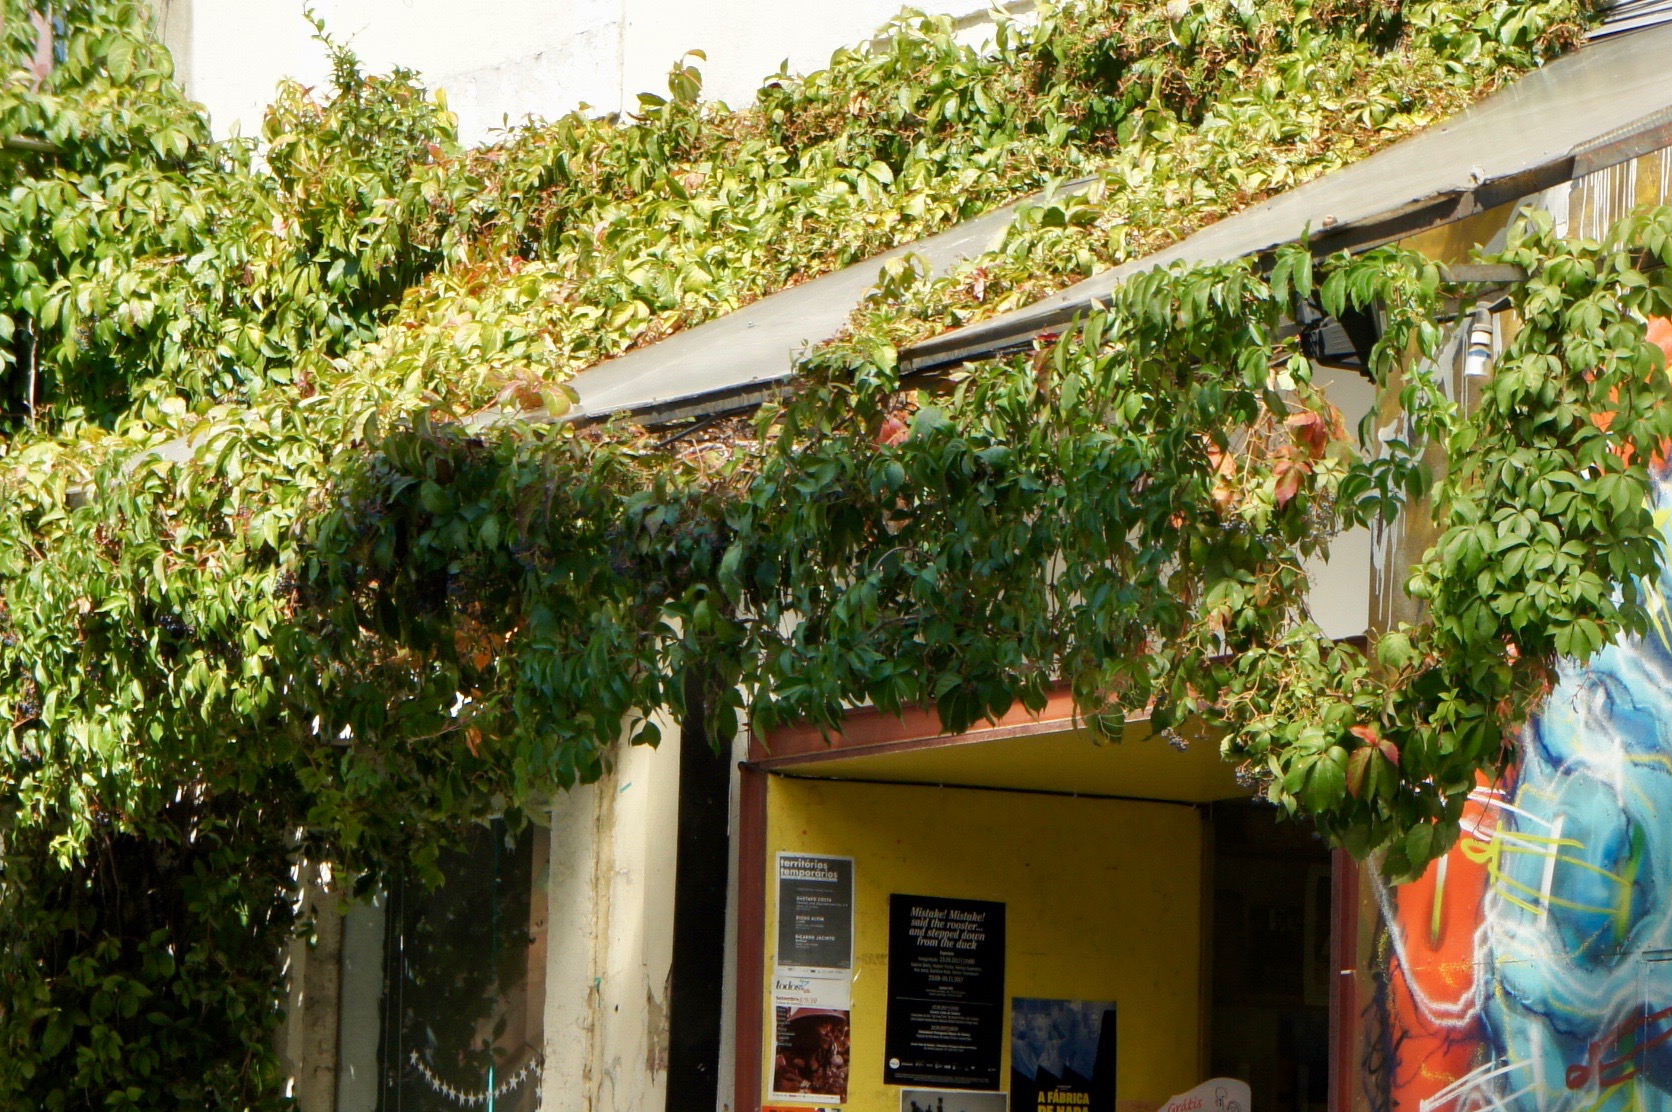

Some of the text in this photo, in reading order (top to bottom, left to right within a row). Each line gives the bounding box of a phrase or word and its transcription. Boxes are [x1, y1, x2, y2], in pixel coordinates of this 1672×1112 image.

[780, 859, 828, 870] territórios
[780, 867, 838, 879] temporários
[910, 906, 985, 921] Mistake! Mistake!
[910, 918, 929, 927] said
[930, 918, 945, 928] the
[909, 927, 985, 941] and stepped down
[916, 936, 977, 950] from the duck
[1037, 1088, 1090, 1105] A FÁBRICA
